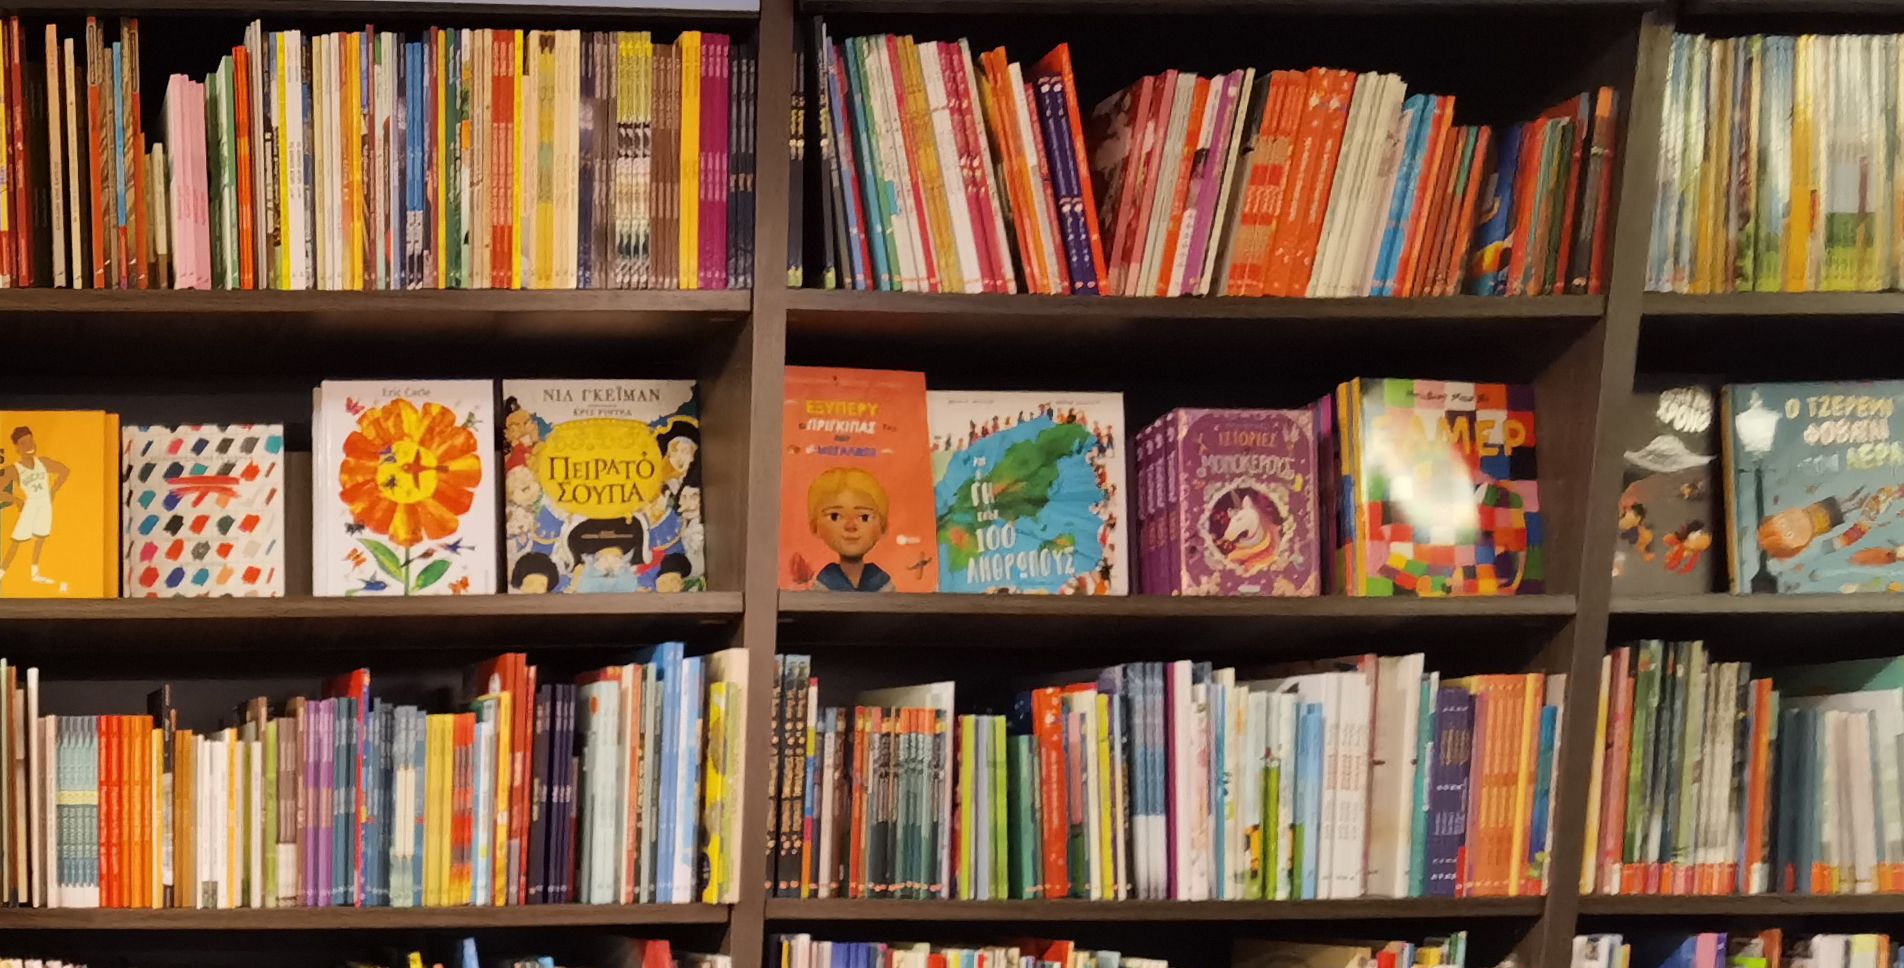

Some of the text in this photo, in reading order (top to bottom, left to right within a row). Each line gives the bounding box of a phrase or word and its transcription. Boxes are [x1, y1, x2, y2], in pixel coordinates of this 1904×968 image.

[543, 385, 661, 402] ΝΙΛ ΓΚΕΪΜΑΝ
[558, 481, 644, 505] ΣΟΥΠΑ
[976, 521, 1017, 552] 100
